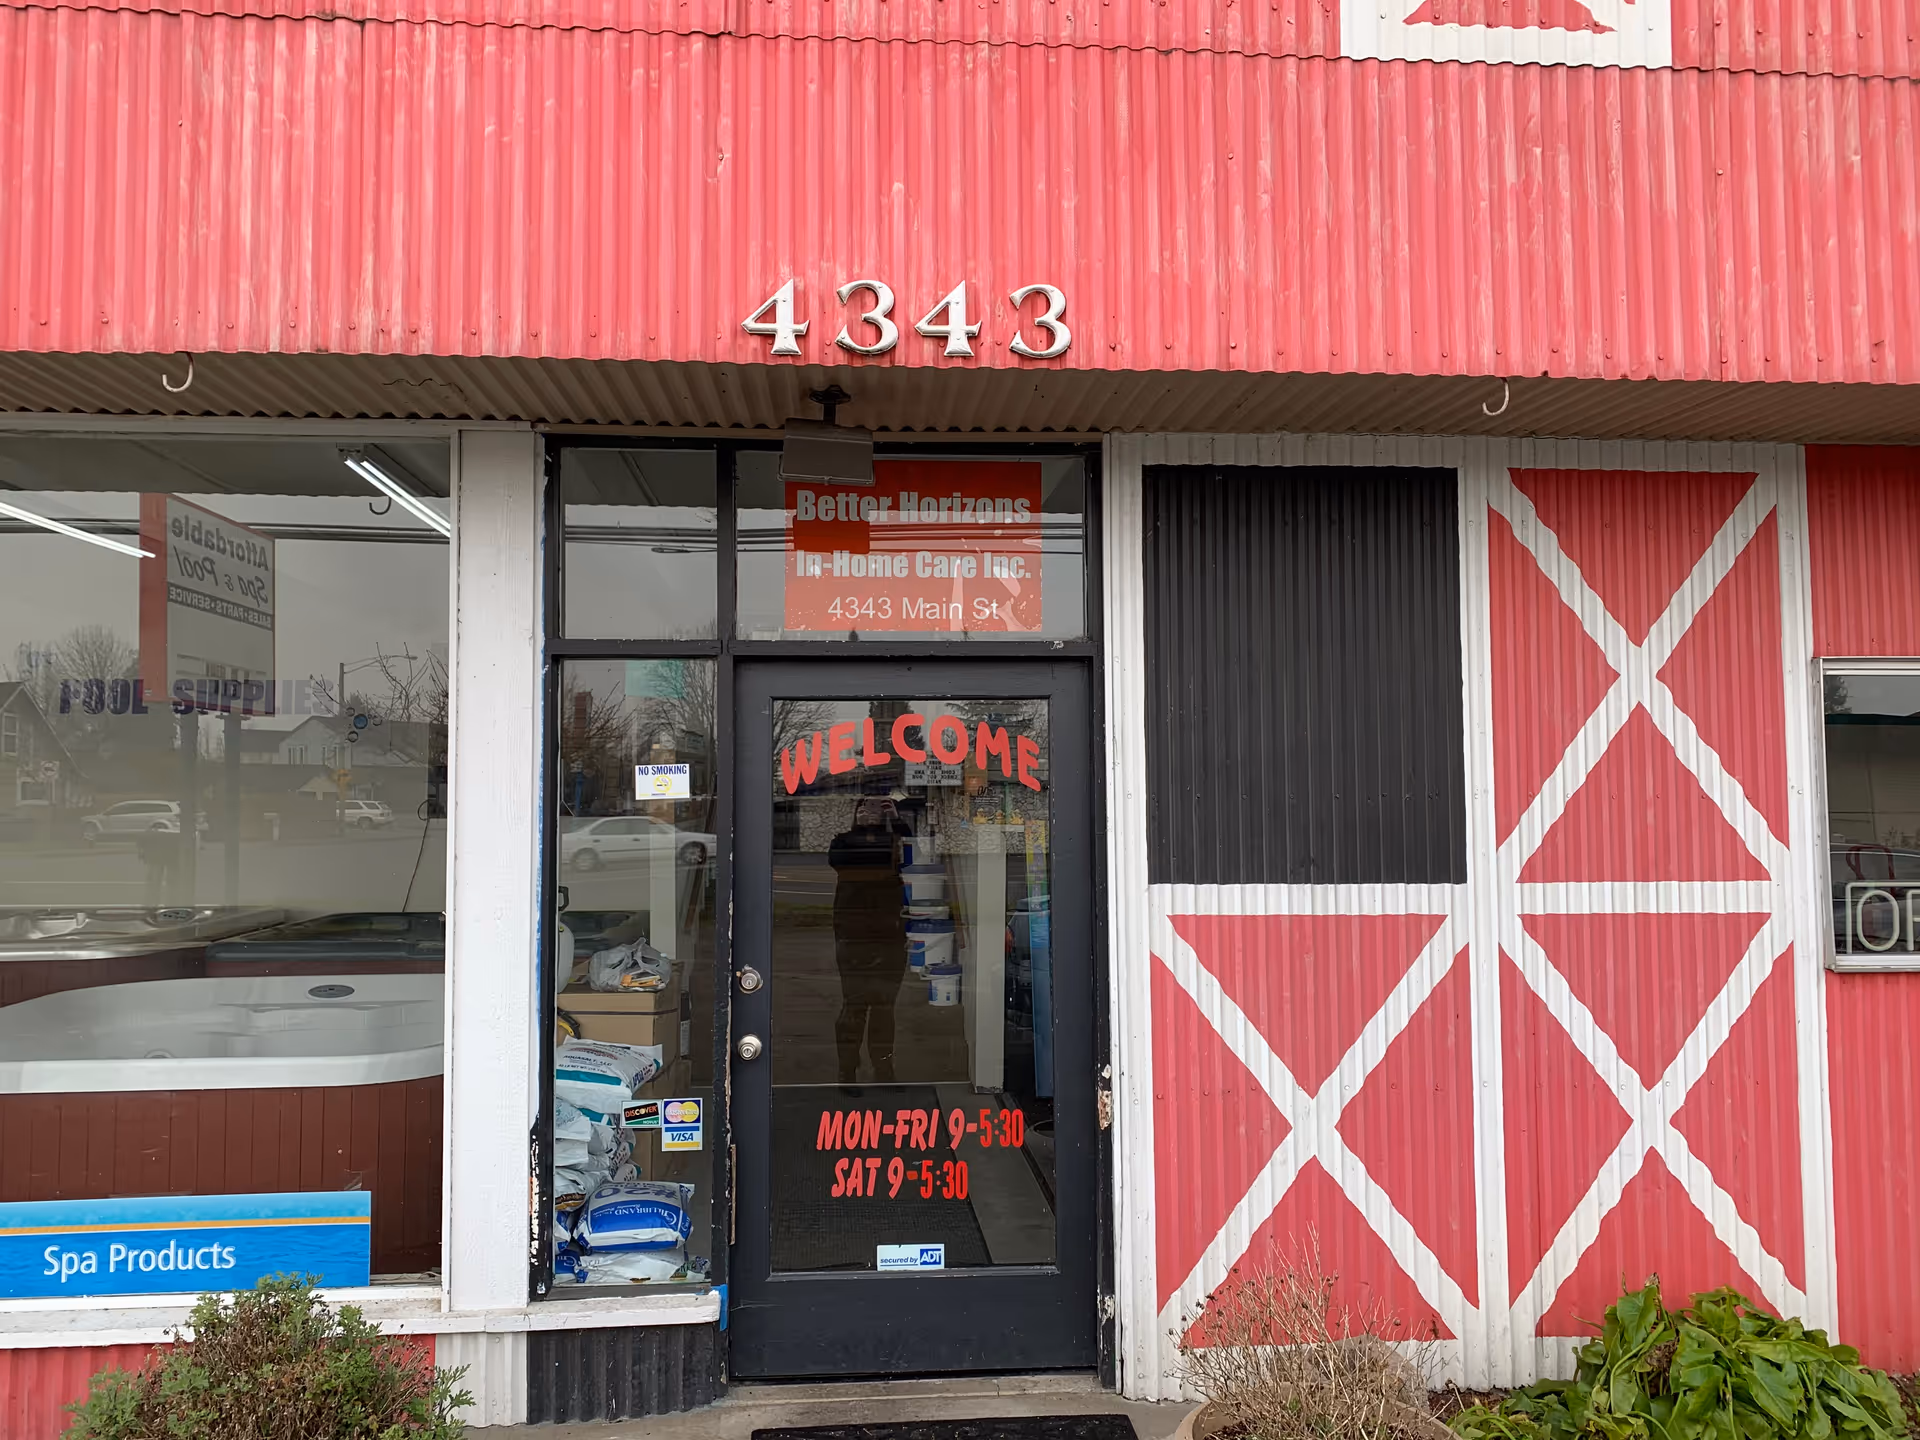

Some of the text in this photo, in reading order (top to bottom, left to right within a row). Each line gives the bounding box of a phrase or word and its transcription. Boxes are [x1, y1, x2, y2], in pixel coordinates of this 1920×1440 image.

[740, 277, 1072, 359] 4343
[796, 489, 1031, 524] Better Horizons
[796, 550, 1032, 579] In-Home Care Inc.
[828, 597, 999, 620] 4343 Main St
[59, 679, 148, 715] POOL
[638, 765, 687, 776] NO SMOKING
[781, 713, 1041, 794] WELCOME
[625, 1106, 657, 1118] DISCOVER
[816, 1108, 1024, 1151] MON-FRI 9-5:30
[671, 1132, 694, 1142] VISA
[831, 1157, 882, 1198] SAT
[43, 1239, 236, 1283] Spa Products
[909, 1256, 918, 1264] by
[920, 1251, 942, 1263] ADT
